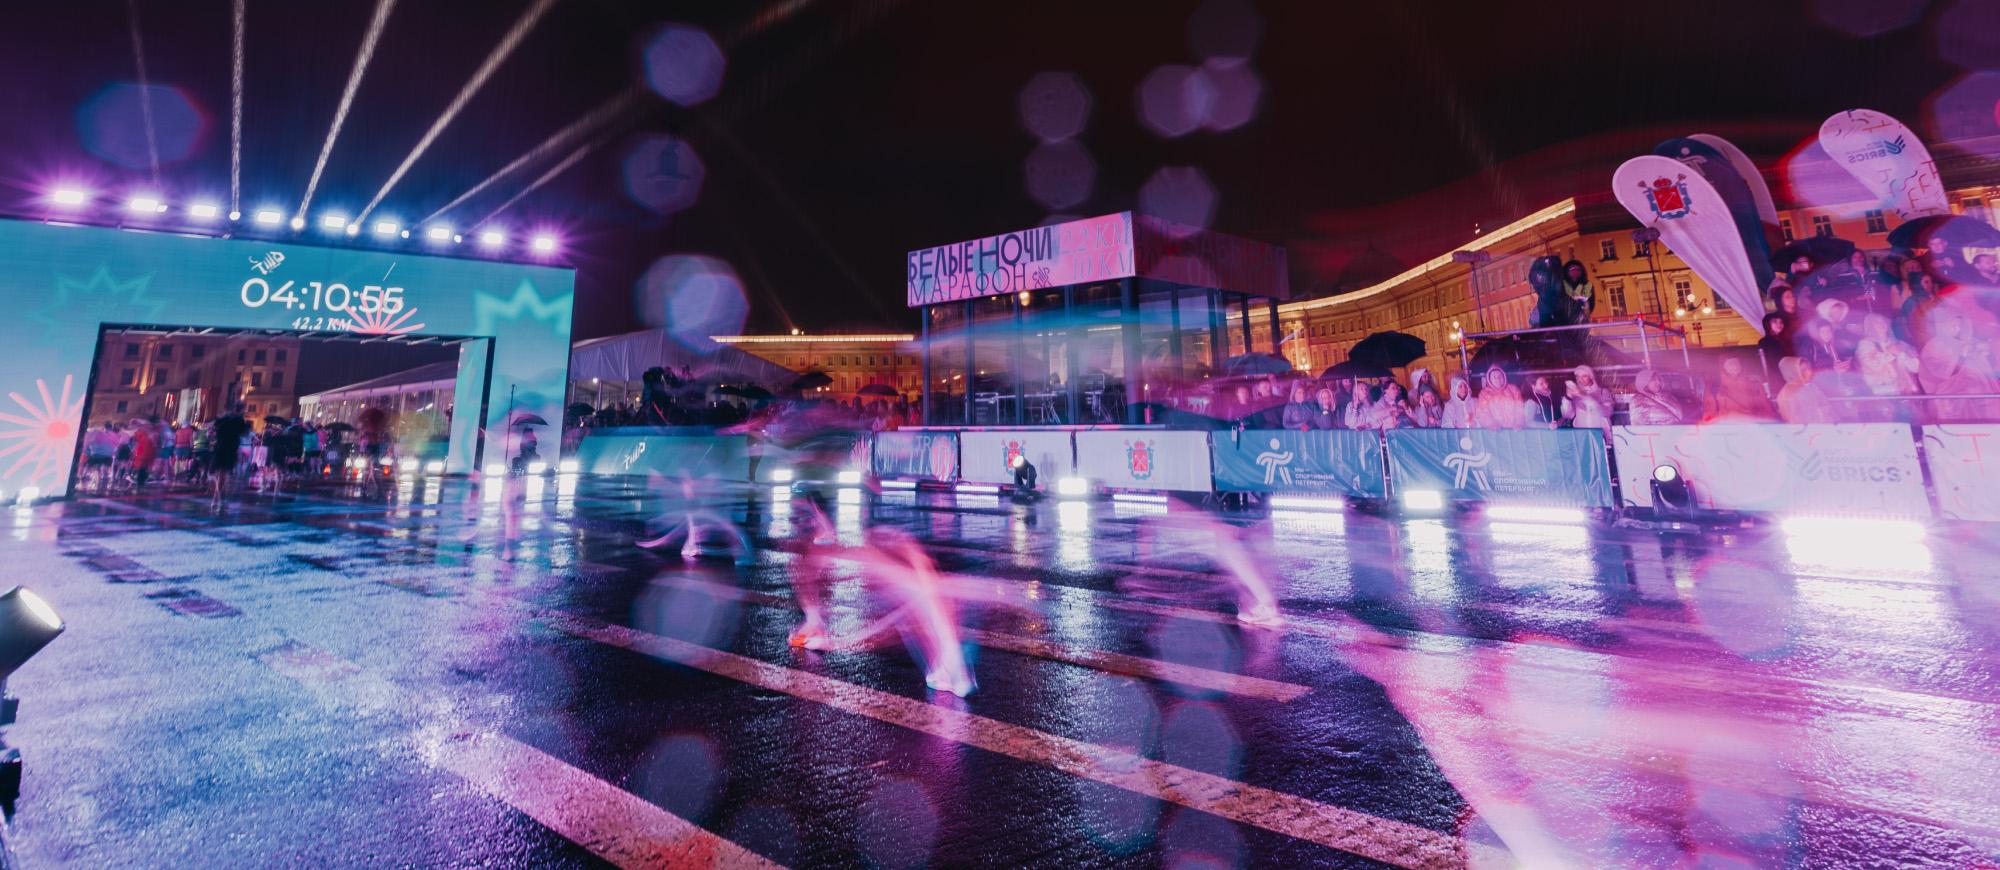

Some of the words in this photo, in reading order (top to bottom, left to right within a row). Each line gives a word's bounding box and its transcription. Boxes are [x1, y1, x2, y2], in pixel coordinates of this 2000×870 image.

[908, 241, 975, 281] БЕЛЫЕ
[979, 226, 1052, 270] НОЧИ
[909, 263, 1027, 305] МАРАФОН
[1827, 466, 1902, 482] BRICS
